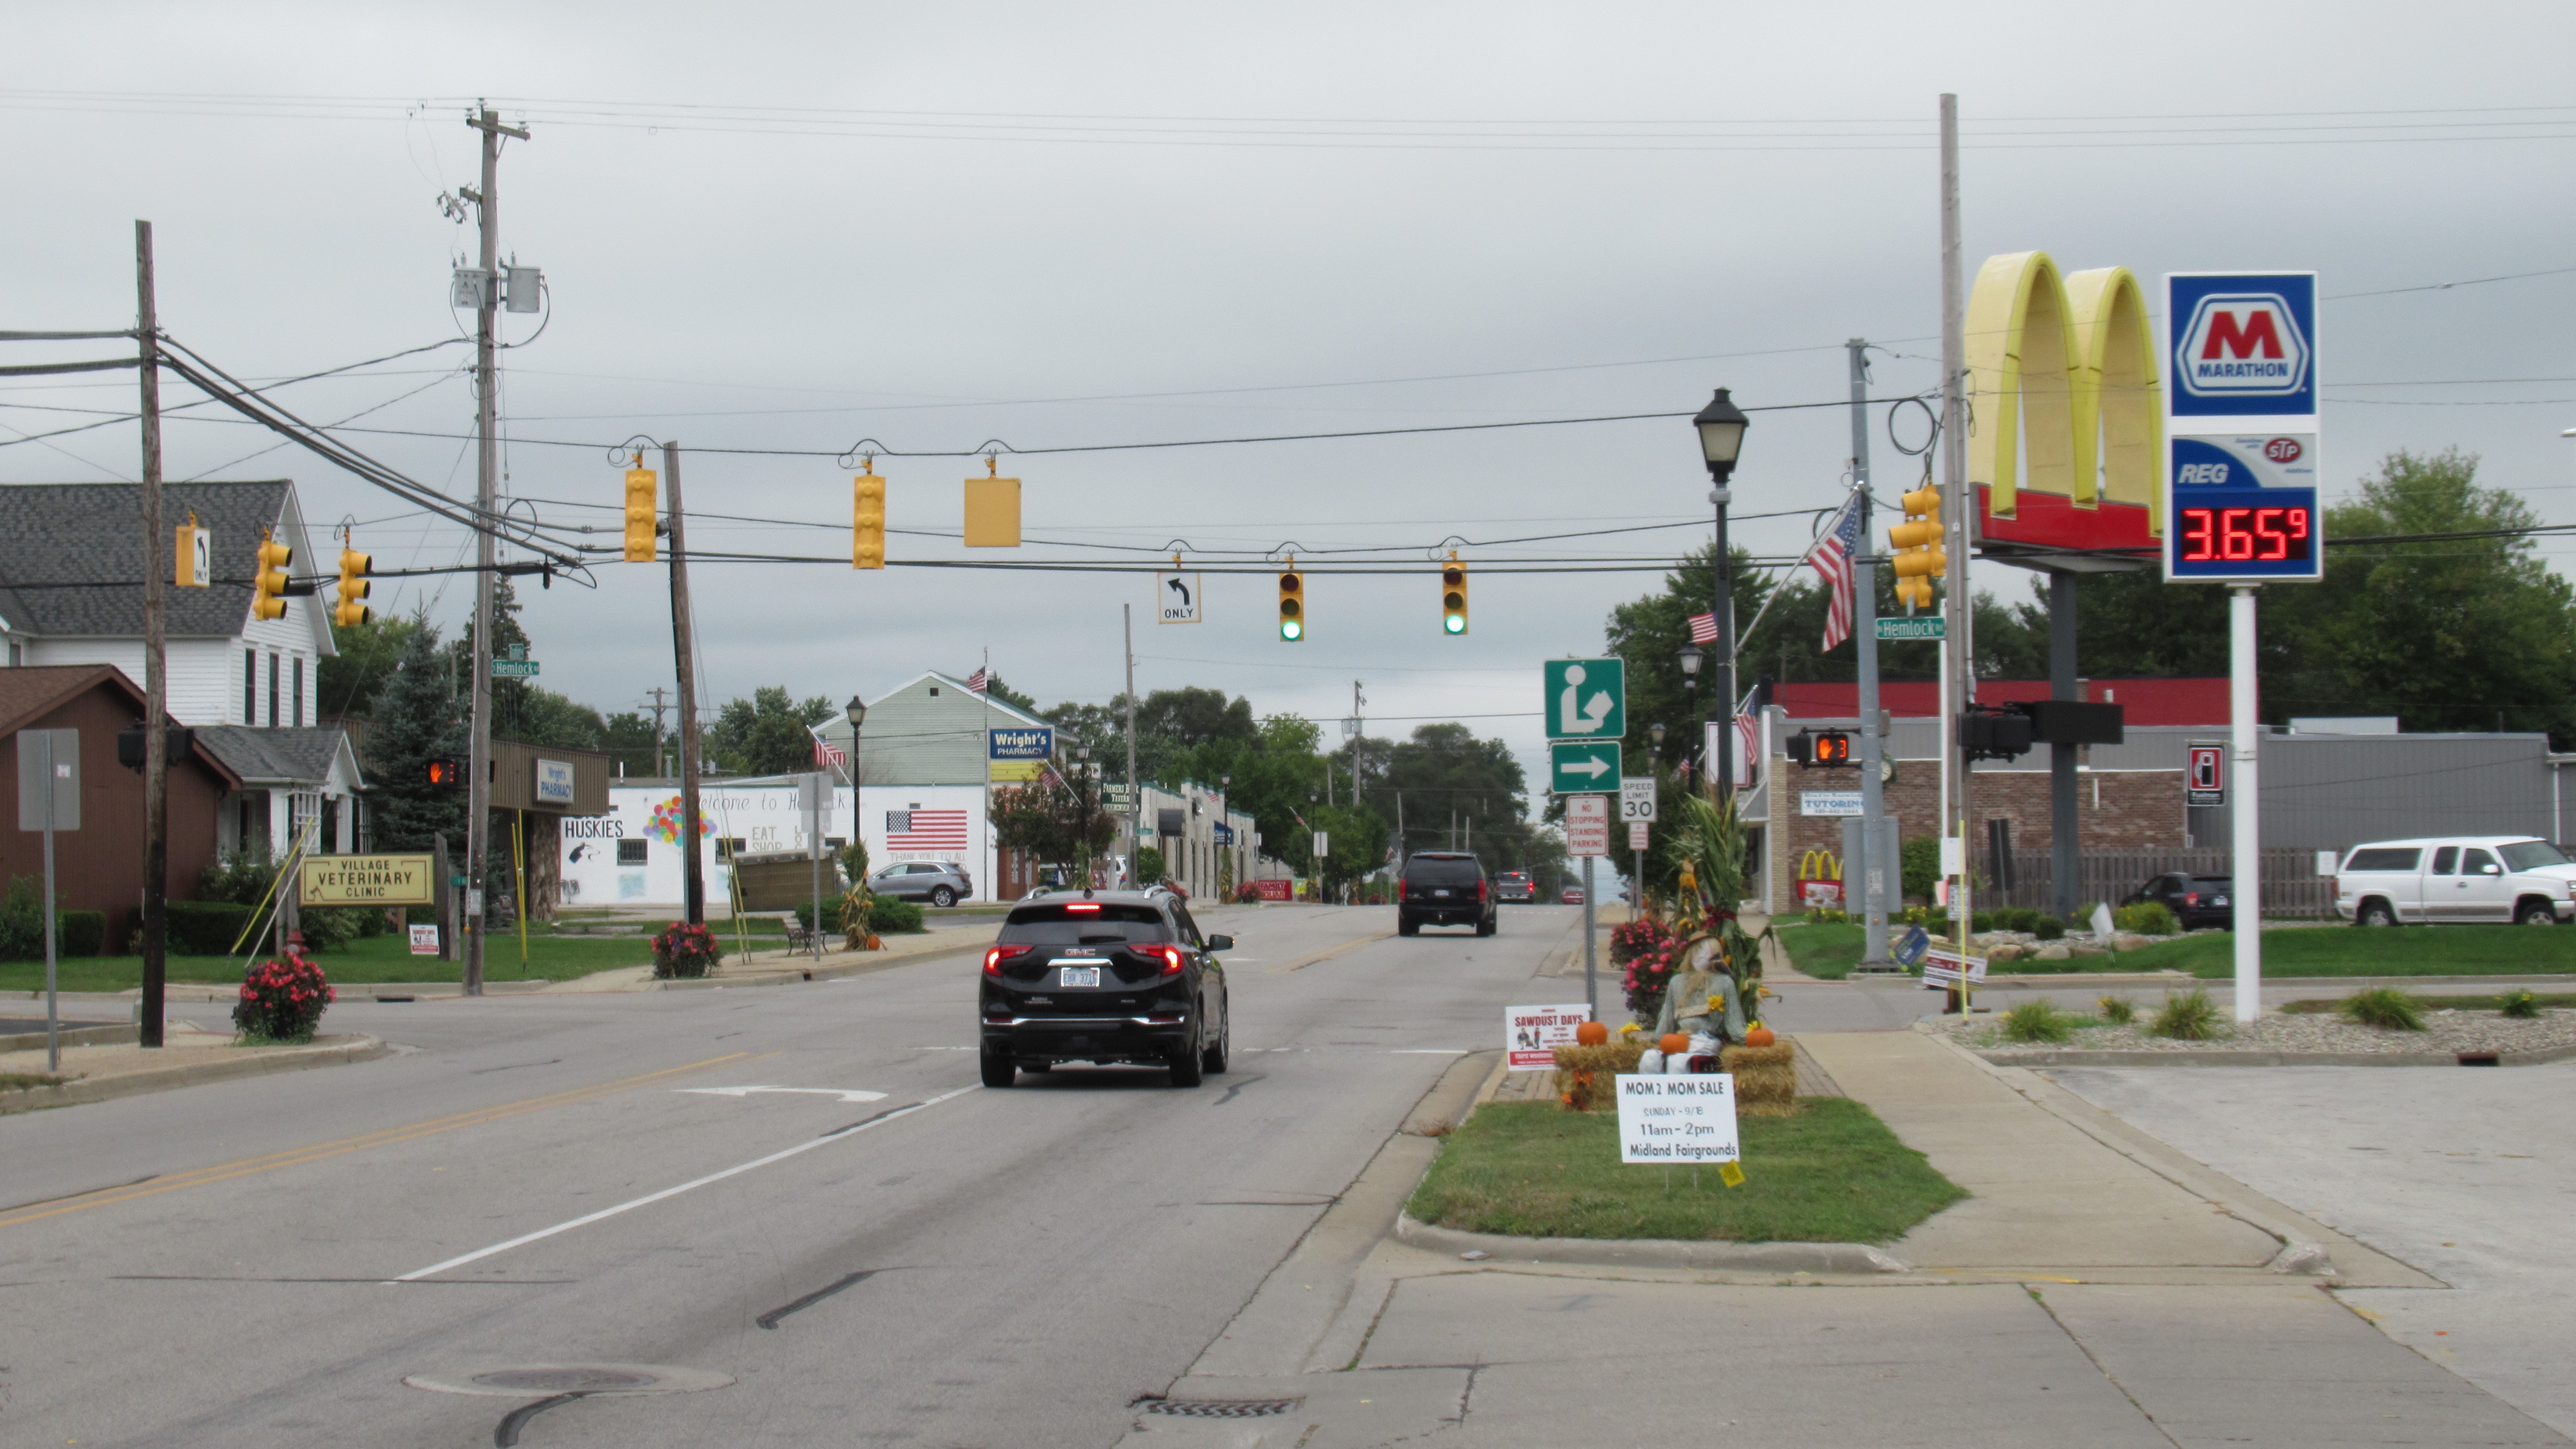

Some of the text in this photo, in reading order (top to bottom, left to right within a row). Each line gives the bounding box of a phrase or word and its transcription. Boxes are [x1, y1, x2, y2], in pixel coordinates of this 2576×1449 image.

[2201, 310, 2285, 359] M
[2198, 363, 2288, 377] MARATHON
[2269, 441, 2298, 459] STP
[2178, 464, 2229, 483] REG
[1165, 608, 1194, 618] ONLY
[1883, 620, 1934, 637] Hemlock
[497, 661, 533, 675] Hemlock
[995, 732, 1046, 747] Wright's
[1839, 739, 1847, 758] 3
[698, 792, 749, 811] elcome
[762, 793, 777, 810] to
[1625, 801, 1652, 817] 30
[565, 820, 623, 838] HUSKIES
[752, 827, 776, 840] EAT
[940, 853, 951, 862] TO
[955, 853, 967, 862] ALL
[342, 861, 390, 870] VILLAGE
[319, 872, 412, 885] VETERINARY
[346, 887, 385, 896] CLINIC
[1515, 1015, 1583, 1026] SAWDUST DAYS
[1626, 1082, 1724, 1095] MOM 2 MOM SALE
[1644, 1107, 1676, 1116] SUNDAY
[1685, 1123, 1714, 1137] 2pm
[1631, 1142, 1736, 1159] Midland Fairgrounds
